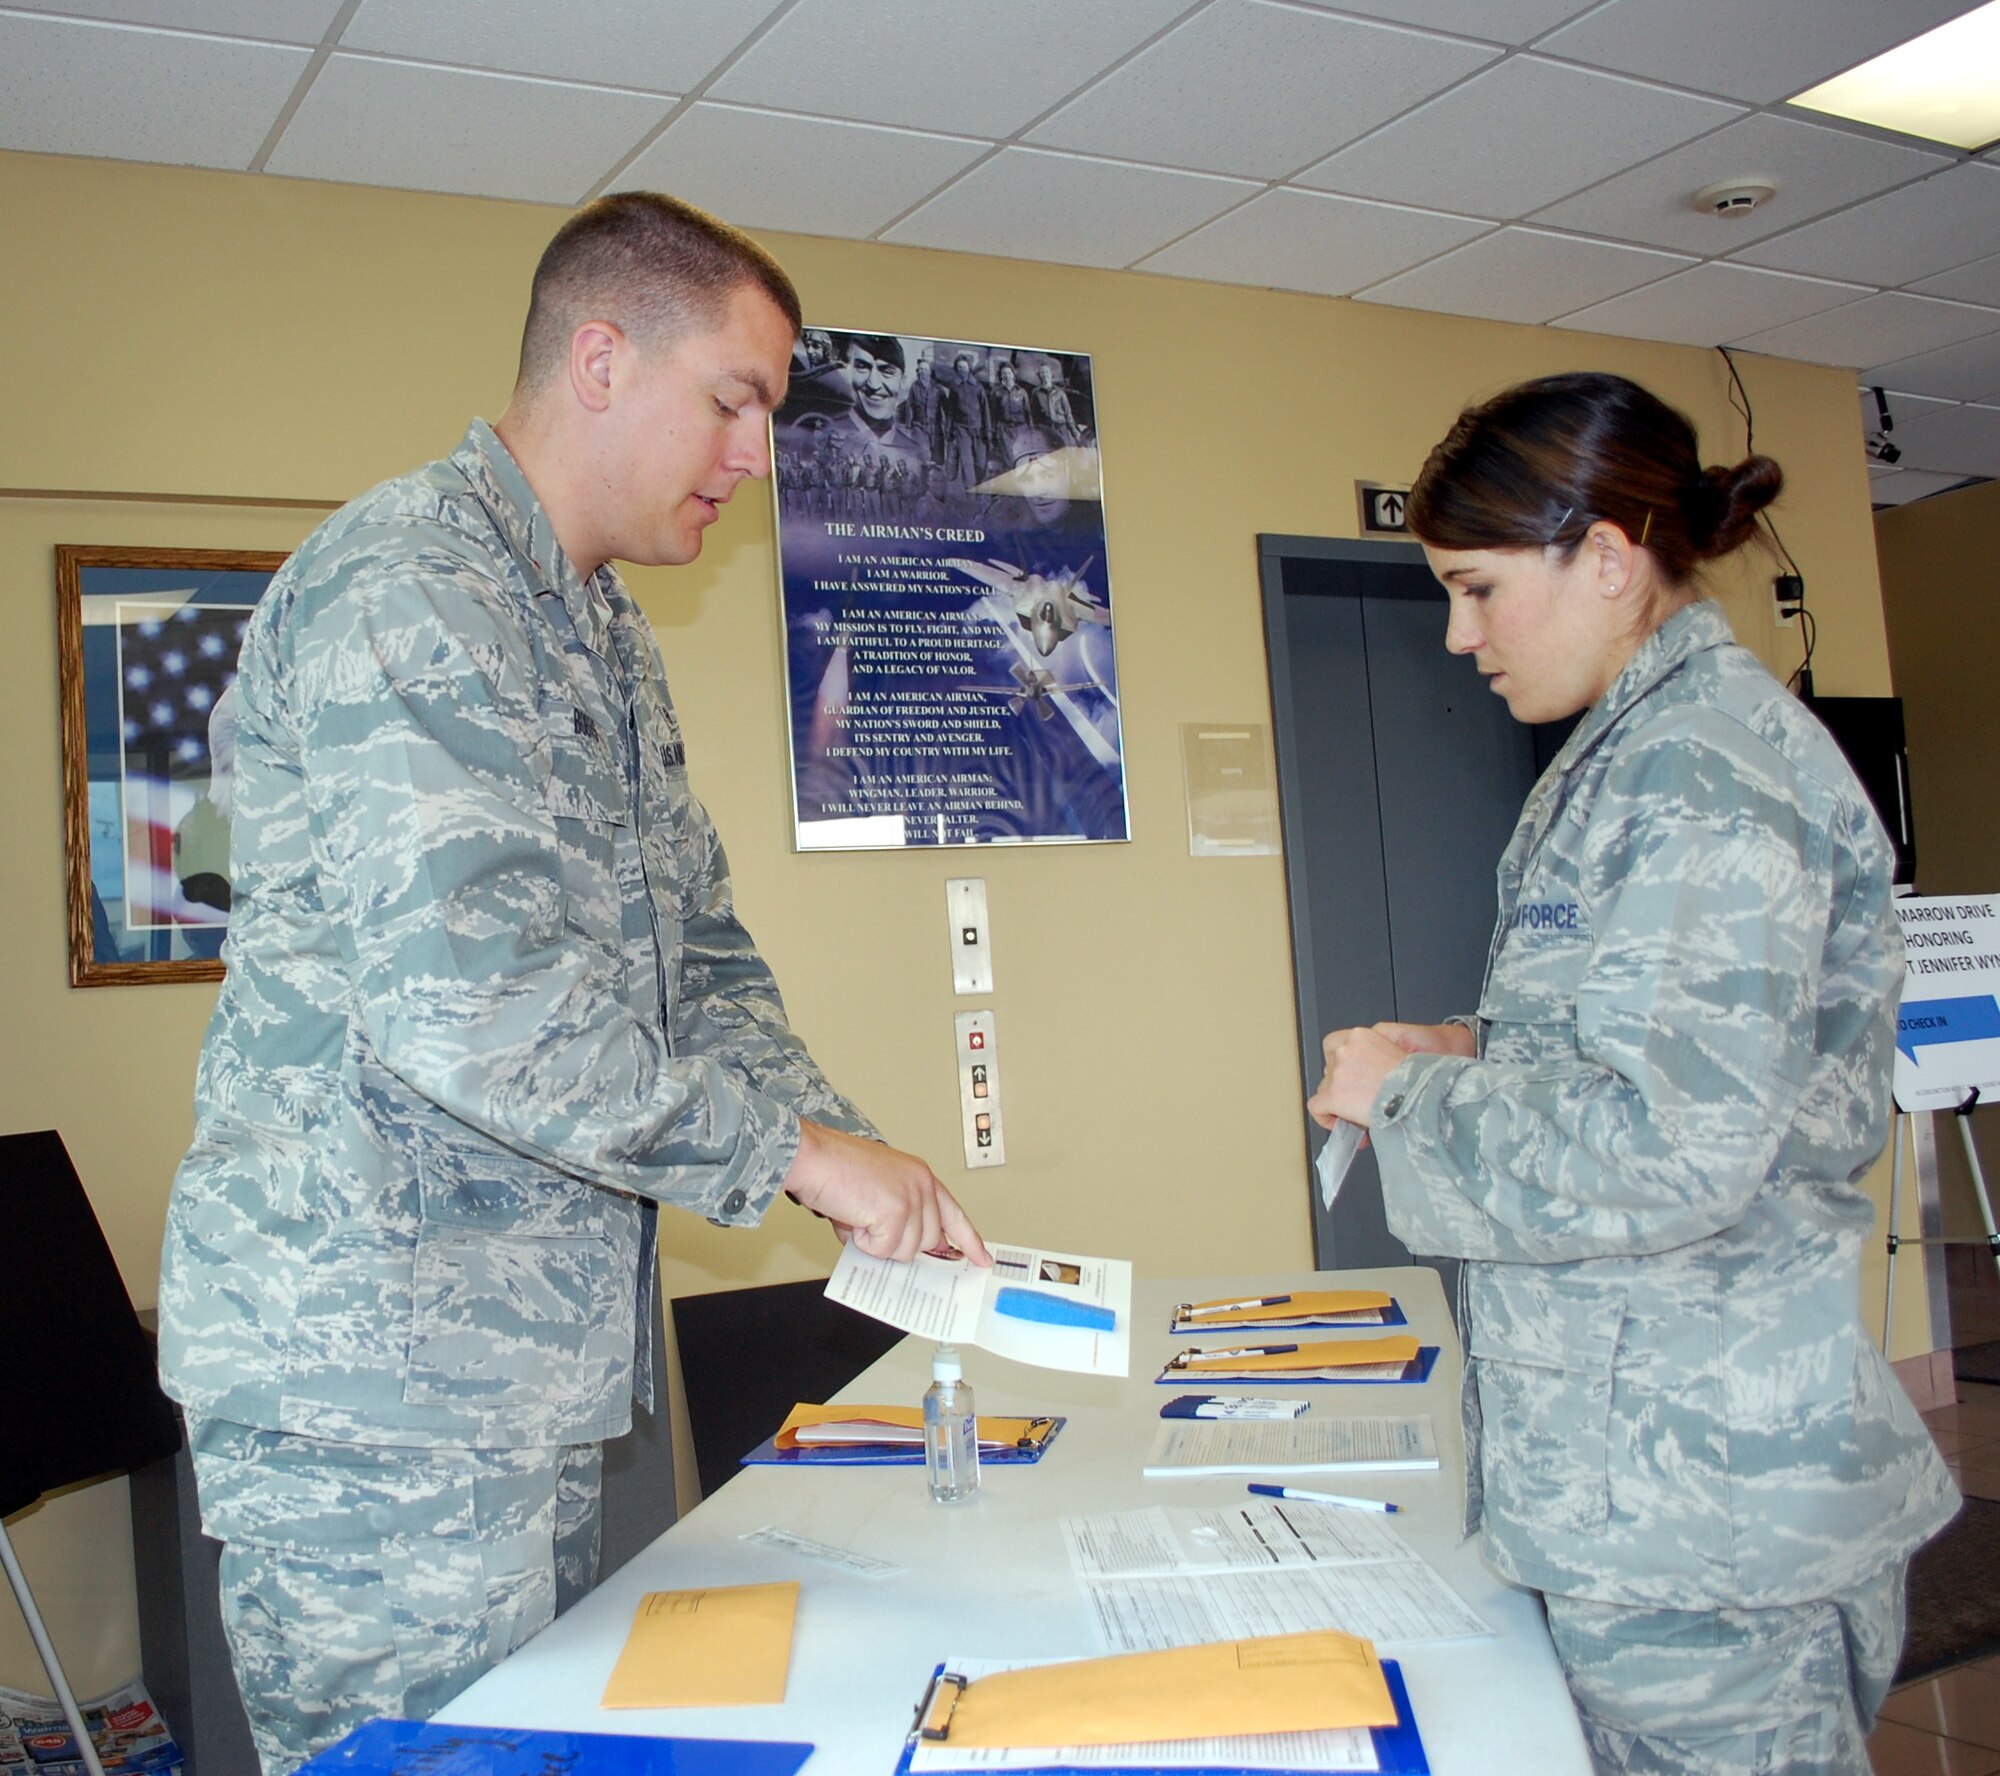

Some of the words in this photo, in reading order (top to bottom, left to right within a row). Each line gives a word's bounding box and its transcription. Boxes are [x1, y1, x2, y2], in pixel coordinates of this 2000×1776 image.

[825, 523, 855, 536] THE
[860, 525, 933, 540] AIRMAN'S
[936, 528, 985, 542] CREED
[838, 554, 841, 563] I
[845, 555, 861, 564] AM
[864, 556, 877, 564] AN
[880, 556, 933, 567] AMERICAN
[868, 570, 871, 578] I
[873, 570, 889, 578] AM
[892, 570, 899, 579] A
[815, 581, 818, 590] I
[821, 581, 847, 590] HAVE
[851, 582, 905, 593] ANSWERED
[908, 585, 923, 593] MY
[925, 585, 970, 595] NATION'S
[842, 609, 846, 618] I
[849, 610, 864, 618] AM
[868, 611, 881, 619] AN
[883, 611, 936, 620] AMERICAN
[816, 623, 830, 631] MY
[834, 623, 875, 632] MISSION
[878, 624, 887, 632] IS
[890, 624, 902, 633] TO
[817, 637, 820, 645] I
[823, 637, 839, 645] AM
[842, 637, 891, 647] FAITHFUL
[894, 638, 907, 647] TO
[910, 639, 916, 647] A
[918, 639, 951, 648] PROUD
[854, 651, 860, 660] A
[863, 651, 918, 661] TRADITION
[920, 652, 932, 661] OF
[852, 665, 873, 674] AND
[876, 665, 882, 674] A
[884, 665, 924, 675] LEGACY
[927, 666, 939, 674] OF
[848, 692, 852, 700] I
[855, 692, 870, 701] AM
[873, 693, 886, 701] AN
[890, 693, 942, 701] AMERICAN
[824, 706, 878, 715] GUARDIAN
[880, 706, 893, 714] OF
[896, 706, 944, 715] FREEDOM
[947, 707, 967, 715] AND
[836, 720, 851, 728] MY
[854, 720, 900, 729] NATION'S
[903, 720, 939, 729] SWORD
[941, 720, 961, 729] AND
[855, 734, 870, 743] ITS
[872, 734, 911, 743] SENTRY
[914, 734, 934, 743] AND
[826, 748, 830, 756] I
[833, 748, 873, 756] DEFEND
[875, 748, 891, 756] MY
[893, 747, 941, 757] COUNTRY
[943, 747, 969, 756] WITH
[972, 747, 987, 756] MY
[989, 747, 1013, 756] LIFE.
[853, 775, 857, 784] I
[860, 775, 876, 784] AM
[879, 775, 893, 784] AN
[895, 774, 948, 784] AMERICAN
[951, 774, 992, 784] AIRMAN:
[822, 803, 825, 813] I
[828, 803, 853, 813] WILL
[857, 803, 891, 812] NEVER
[893, 802, 925, 812] LEAVE
[928, 802, 941, 811] AN
[944, 801, 983, 811] AIRMAN
[904, 815, 937, 825] NEVER
[904, 829, 930, 839] WILL
[1521, 903, 1579, 929] FORCE
[1896, 906, 1955, 922] MARROW
[1957, 904, 1995, 919] DRIVE
[1905, 931, 1973, 948] HONORING
[1918, 957, 1974, 974] JENNIFER
[1909, 1017, 1935, 1030] CHECK
[1936, 1016, 1947, 1027] IN
[23, 1725, 69, 1733] Walma
